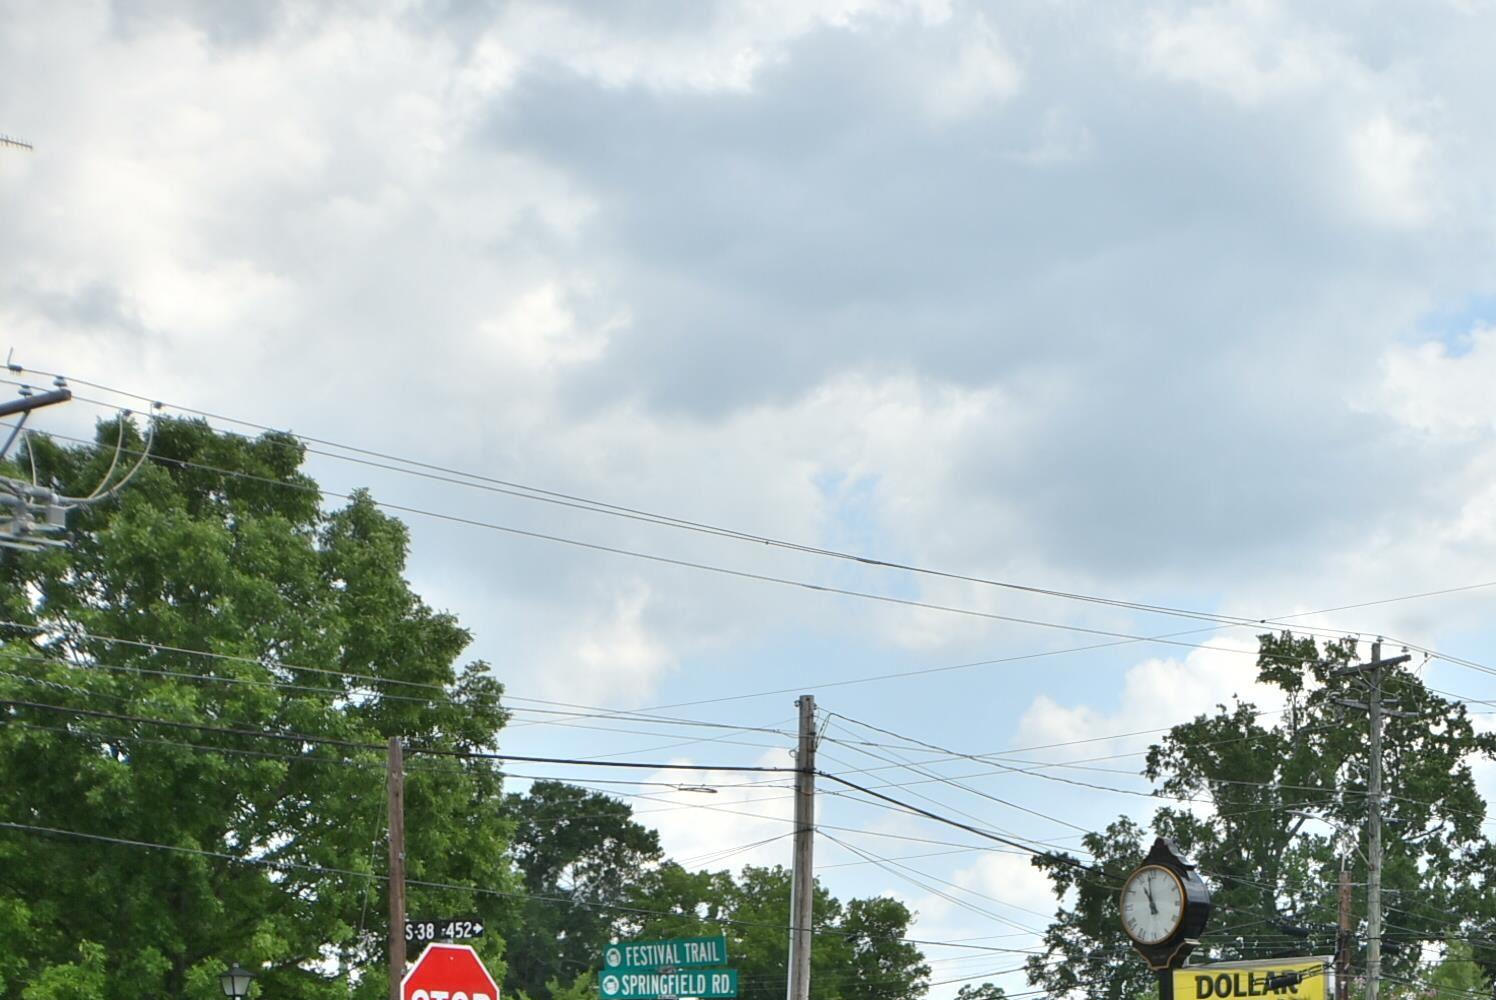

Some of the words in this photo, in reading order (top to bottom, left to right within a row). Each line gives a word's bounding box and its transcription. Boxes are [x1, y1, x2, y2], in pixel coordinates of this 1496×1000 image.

[405, 923, 435, 940] S-38
[625, 943, 681, 967] FESTIVAL
[684, 941, 720, 963] TRAIL
[621, 974, 706, 996] SPRINGFIELD
[711, 973, 735, 995] RD.
